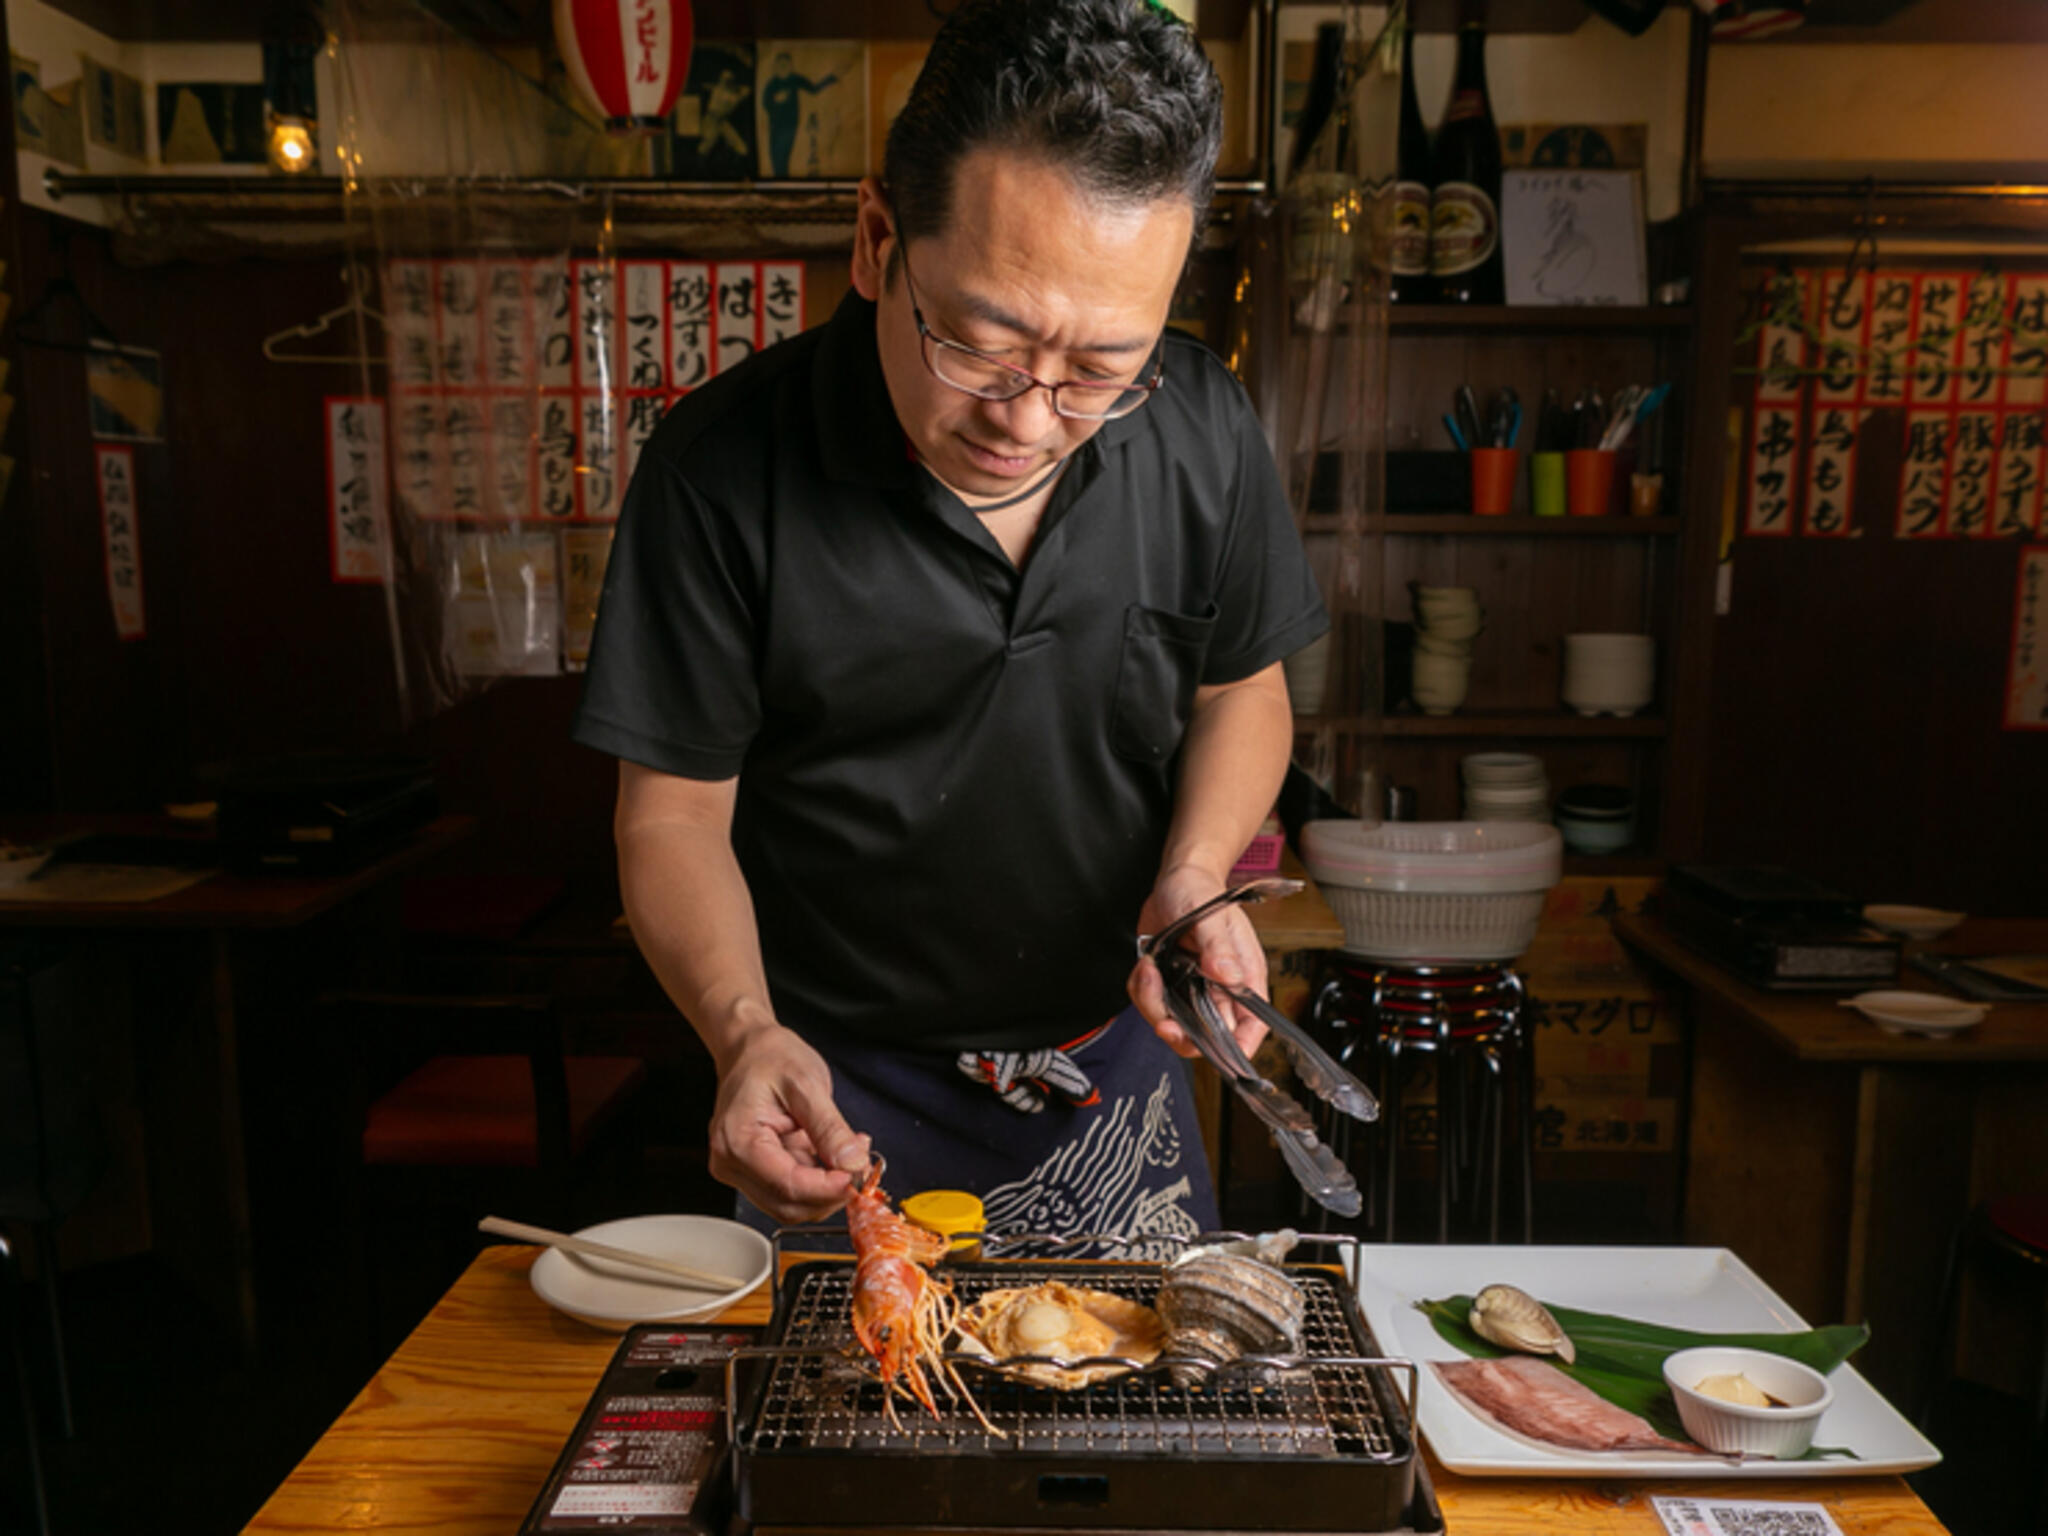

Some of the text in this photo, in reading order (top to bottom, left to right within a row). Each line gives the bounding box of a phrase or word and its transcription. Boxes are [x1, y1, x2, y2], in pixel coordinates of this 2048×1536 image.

[628, 313, 663, 388] つくね
[669, 275, 712, 385] 砂ずり
[1757, 411, 1794, 526] 串カツ
[1904, 418, 1948, 532] 豚バラ
